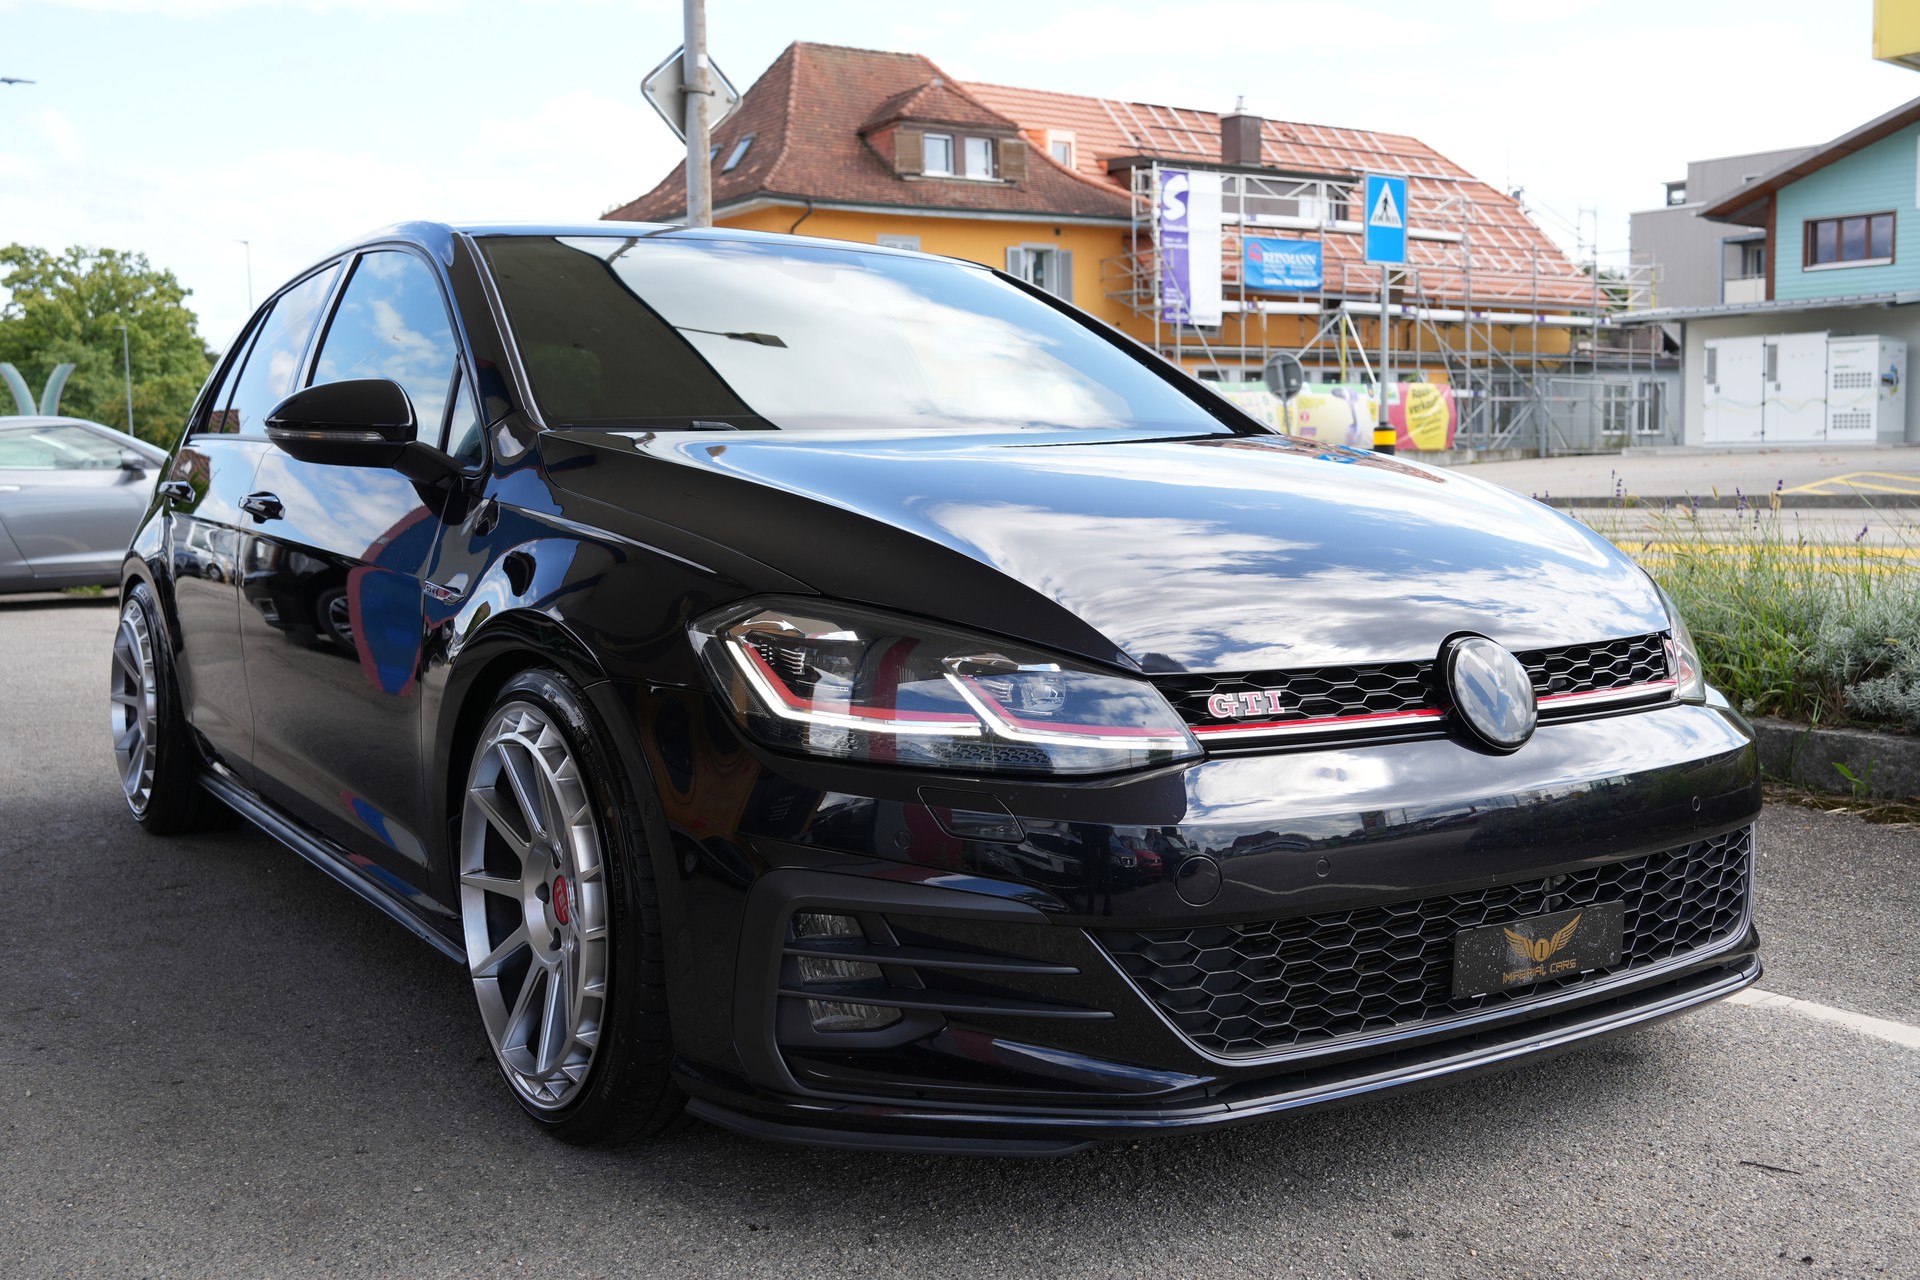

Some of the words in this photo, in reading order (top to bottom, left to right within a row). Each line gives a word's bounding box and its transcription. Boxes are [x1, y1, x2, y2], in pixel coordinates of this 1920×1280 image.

[1208, 690, 1284, 718] GTI
[1503, 966, 1546, 985] IMPERIAL
[1549, 958, 1577, 973] CARS
